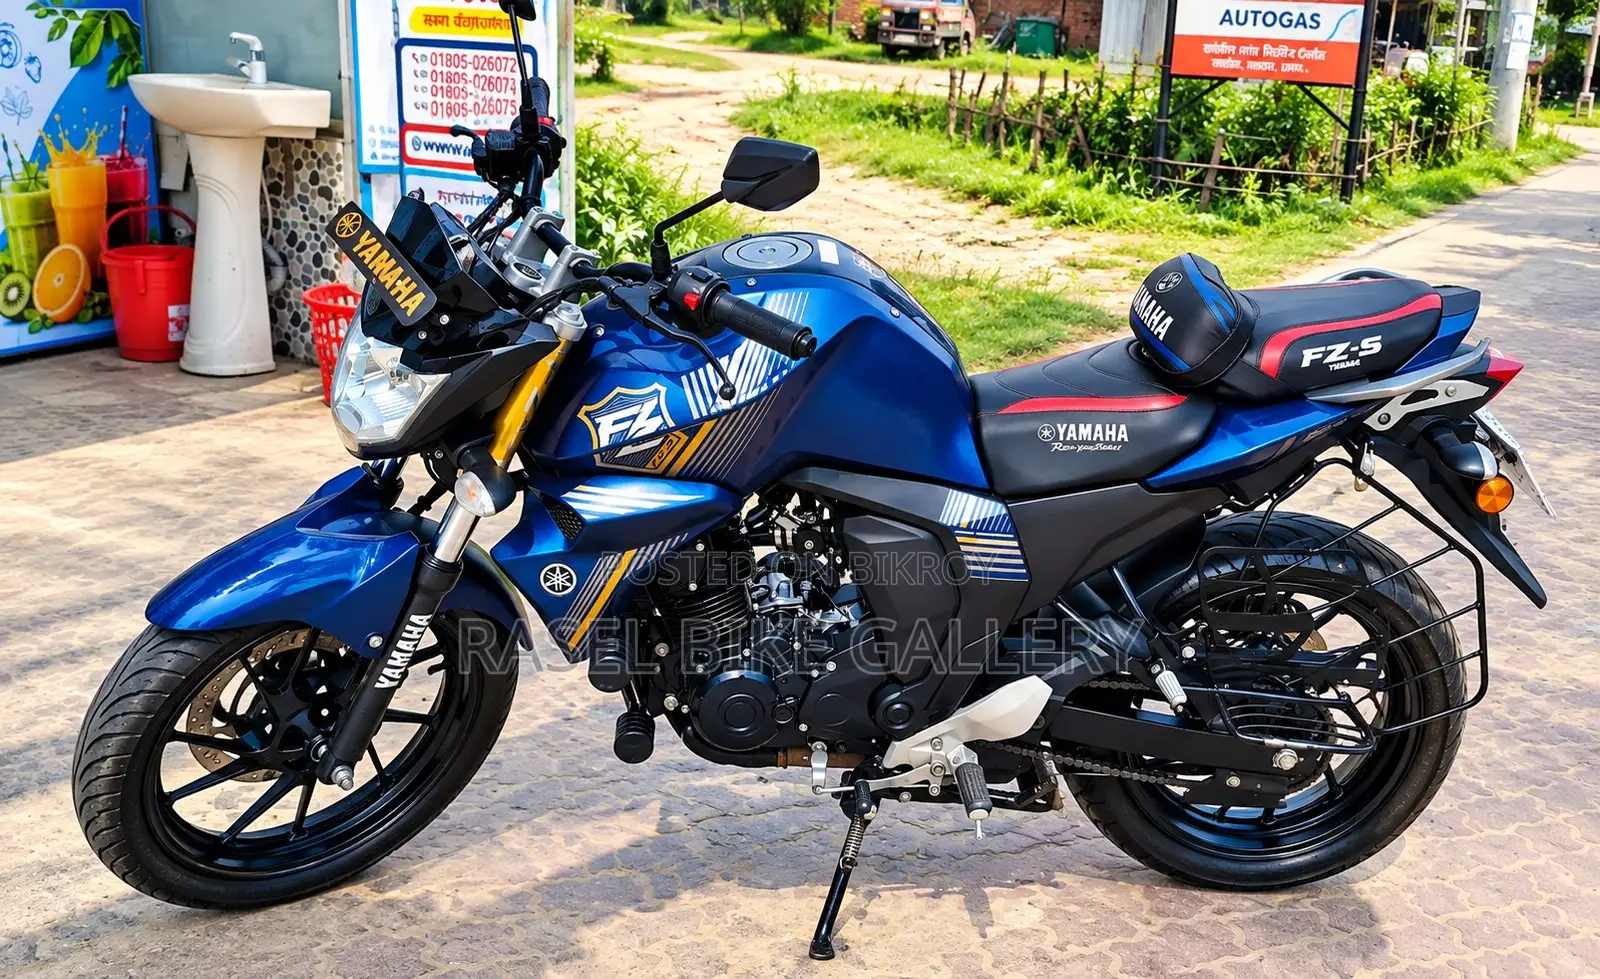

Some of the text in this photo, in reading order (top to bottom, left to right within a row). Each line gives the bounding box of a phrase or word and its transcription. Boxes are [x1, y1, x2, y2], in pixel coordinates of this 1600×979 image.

[1219, 8, 1321, 30] AUTOGAS
[430, 52, 517, 73] 01805-026072
[352, 229, 426, 318] YAMAHA
[1301, 335, 1382, 368] FZ-S
[1056, 423, 1129, 442] YAMAHA
[373, 614, 433, 689] YAMAHA
